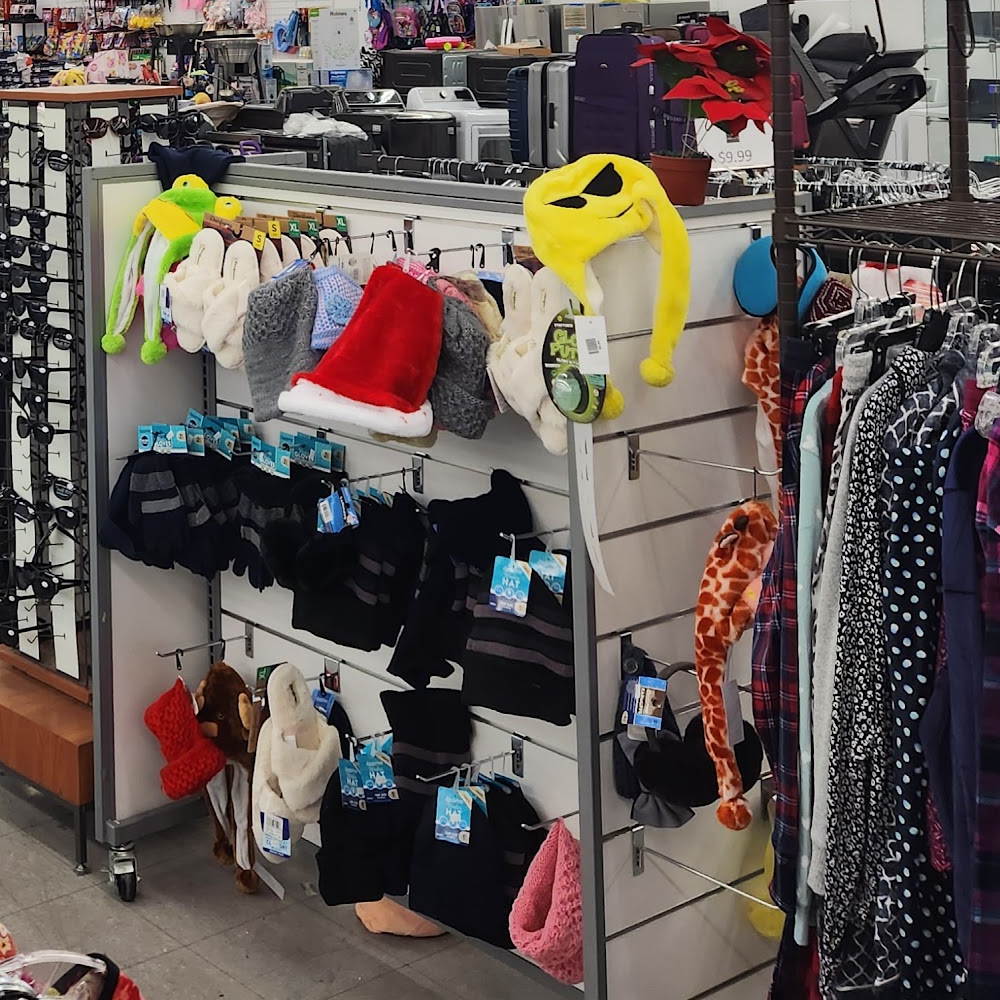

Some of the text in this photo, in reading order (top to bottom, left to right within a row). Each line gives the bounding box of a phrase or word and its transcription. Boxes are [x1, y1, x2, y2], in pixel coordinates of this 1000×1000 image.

[718, 149, 753, 164] $9.99
[308, 220, 318, 231] XL
[336, 216, 347, 226] XL
[271, 223, 277, 232] S
[289, 222, 299, 232] XL
[256, 234, 262, 243] S
[502, 576, 520, 588] HAT
[369, 771, 386, 779] HAT
[346, 777, 359, 786] HAT
[445, 807, 463, 817] HAT
